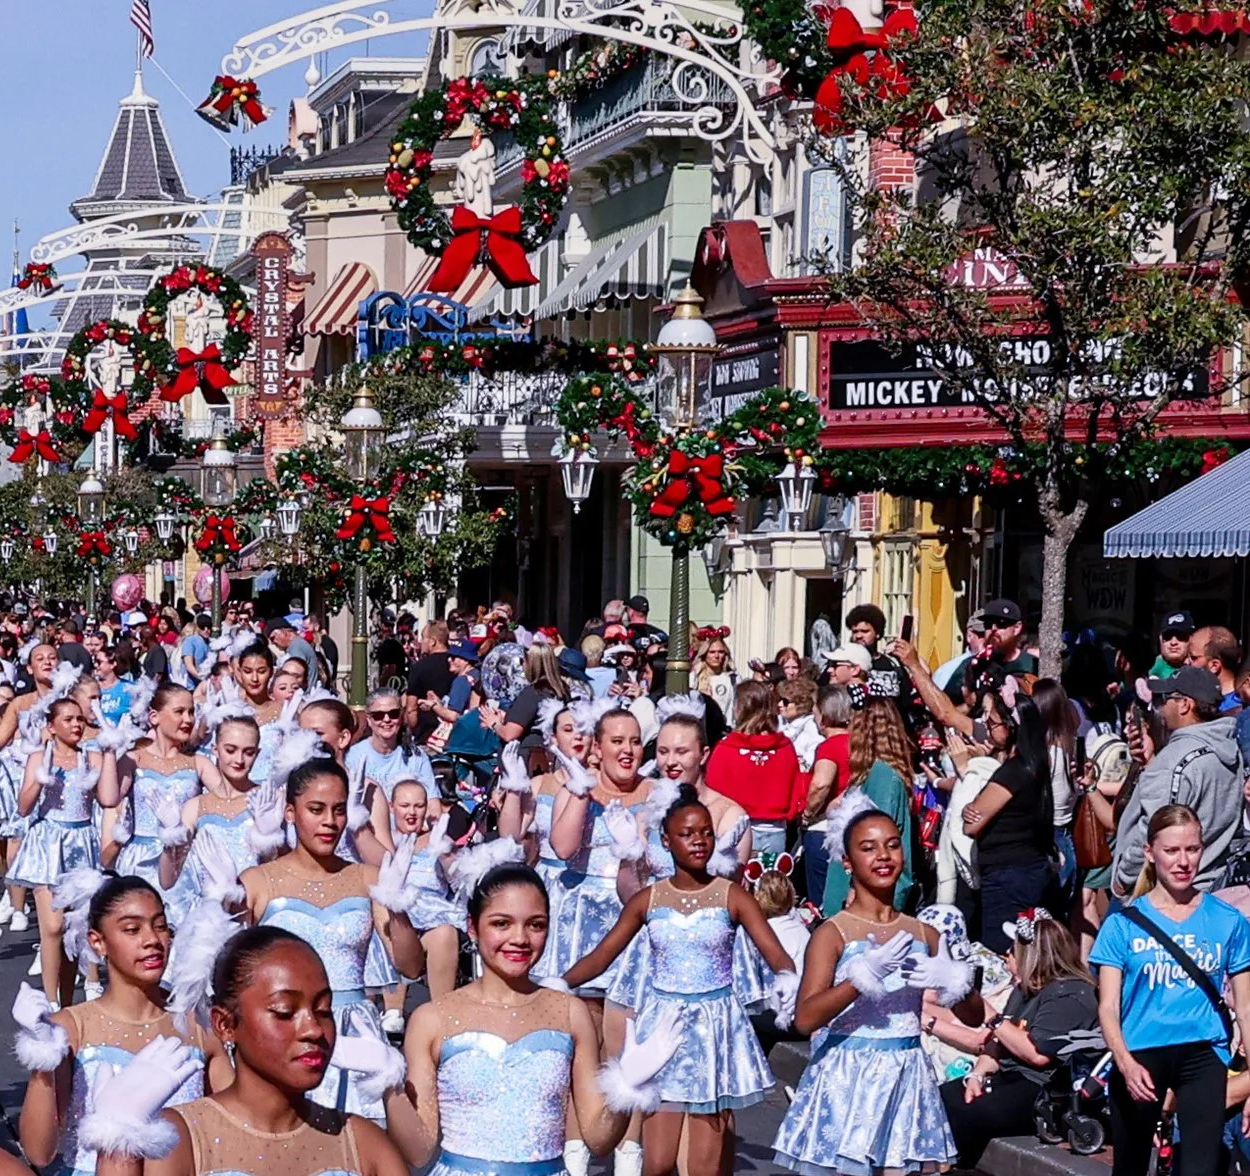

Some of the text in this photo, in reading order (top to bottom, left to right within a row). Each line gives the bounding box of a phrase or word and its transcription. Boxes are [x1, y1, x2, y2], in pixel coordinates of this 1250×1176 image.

[263, 258, 280, 394] CRYSTAL ARTS
[846, 380, 943, 406] MICKEY
[1133, 934, 1196, 953] DACE
